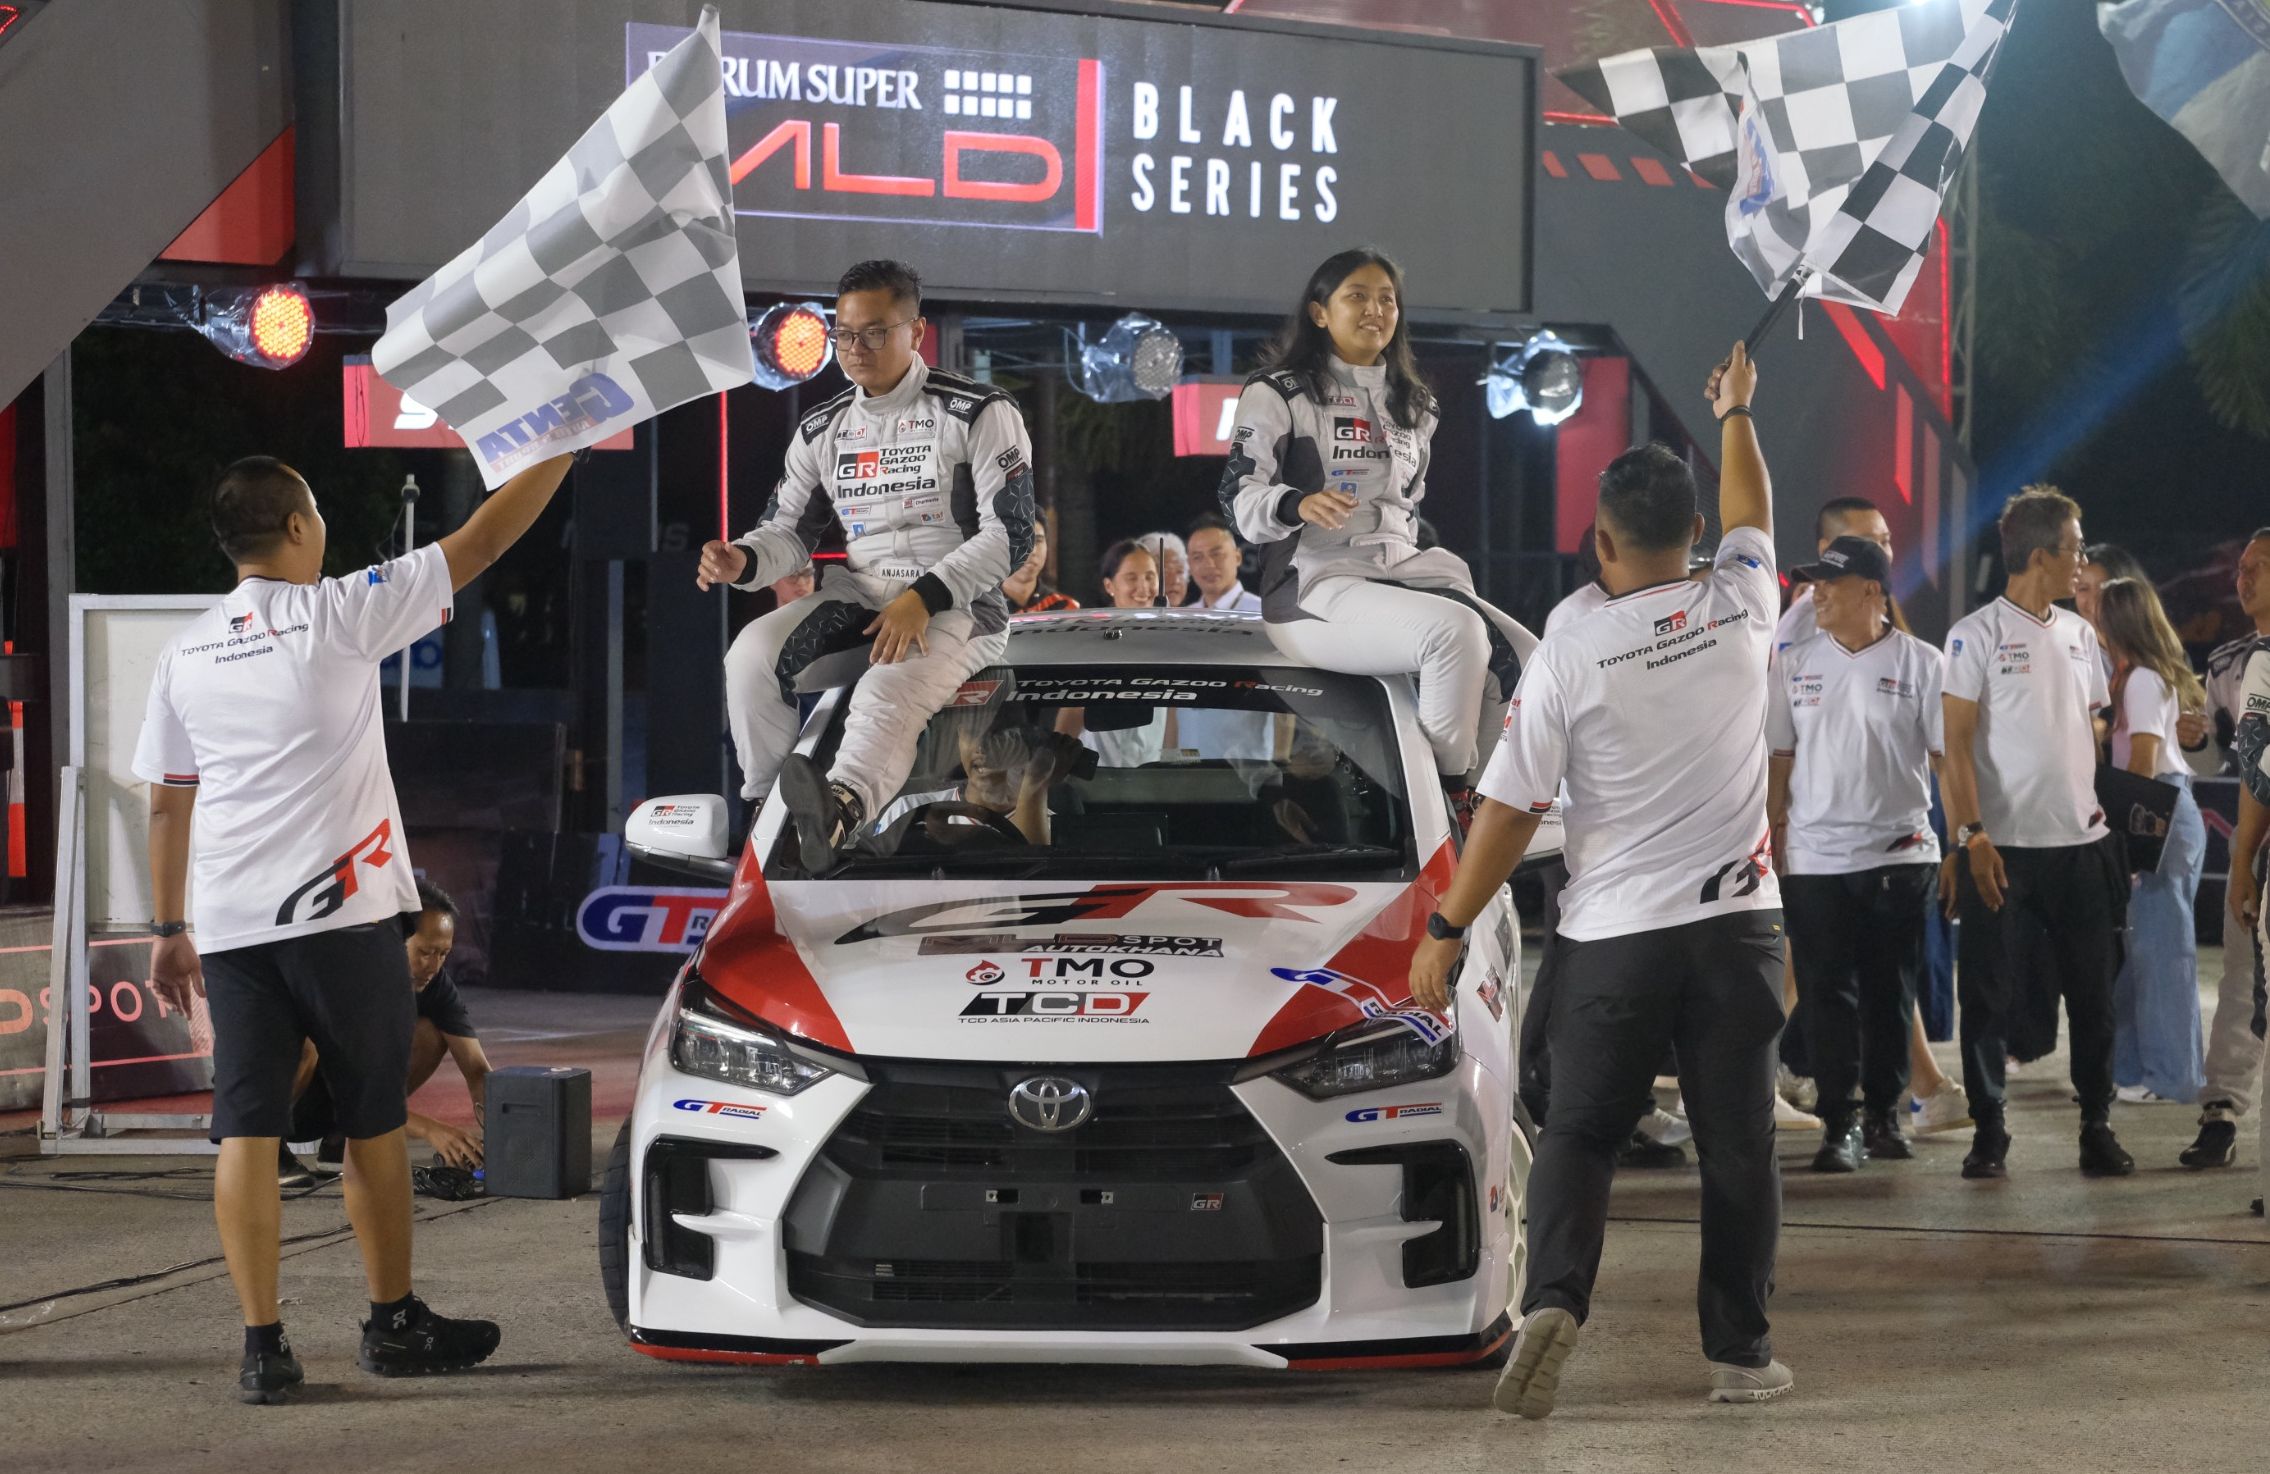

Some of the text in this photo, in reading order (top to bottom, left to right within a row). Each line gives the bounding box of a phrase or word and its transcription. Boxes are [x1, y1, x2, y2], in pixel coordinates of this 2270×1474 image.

[806, 64, 923, 110] SUPER
[1132, 81, 1339, 154] BLACK
[1131, 153, 1339, 223] SERIES
[950, 400, 971, 411] OMP
[805, 415, 828, 432] OMP
[908, 419, 934, 429] TMO
[1337, 426, 1370, 441] GR
[880, 445, 931, 457] TOYOTA
[880, 455, 926, 466] GAZOO
[998, 448, 1020, 468] OMP
[838, 462, 876, 479] GR
[880, 465, 921, 476] Racing
[838, 477, 936, 499] Indonesia
[882, 568, 920, 578] ANJASARA
[182, 622, 310, 656] TOYOTA GAZOO Racing
[1011, 625, 1254, 636] ndonesia
[1597, 608, 1749, 669] TOYOTA GAZOO Racing
[215, 645, 273, 664] Indonesia
[1646, 638, 1717, 670] Indonesia
[1005, 688, 1197, 702] Indonesia
[1017, 679, 1122, 688] TOYOTA
[1130, 678, 1227, 688] GAZOO
[1234, 680, 1324, 697] Racing
[276, 818, 392, 926] GR
[835, 882, 1358, 944] GR
[1022, 946, 1223, 957] AUTOKHANA
[1021, 958, 1154, 977] TMO
[980, 993, 1131, 1015] TCD
[723, 1107, 760, 1116] RADIAL
